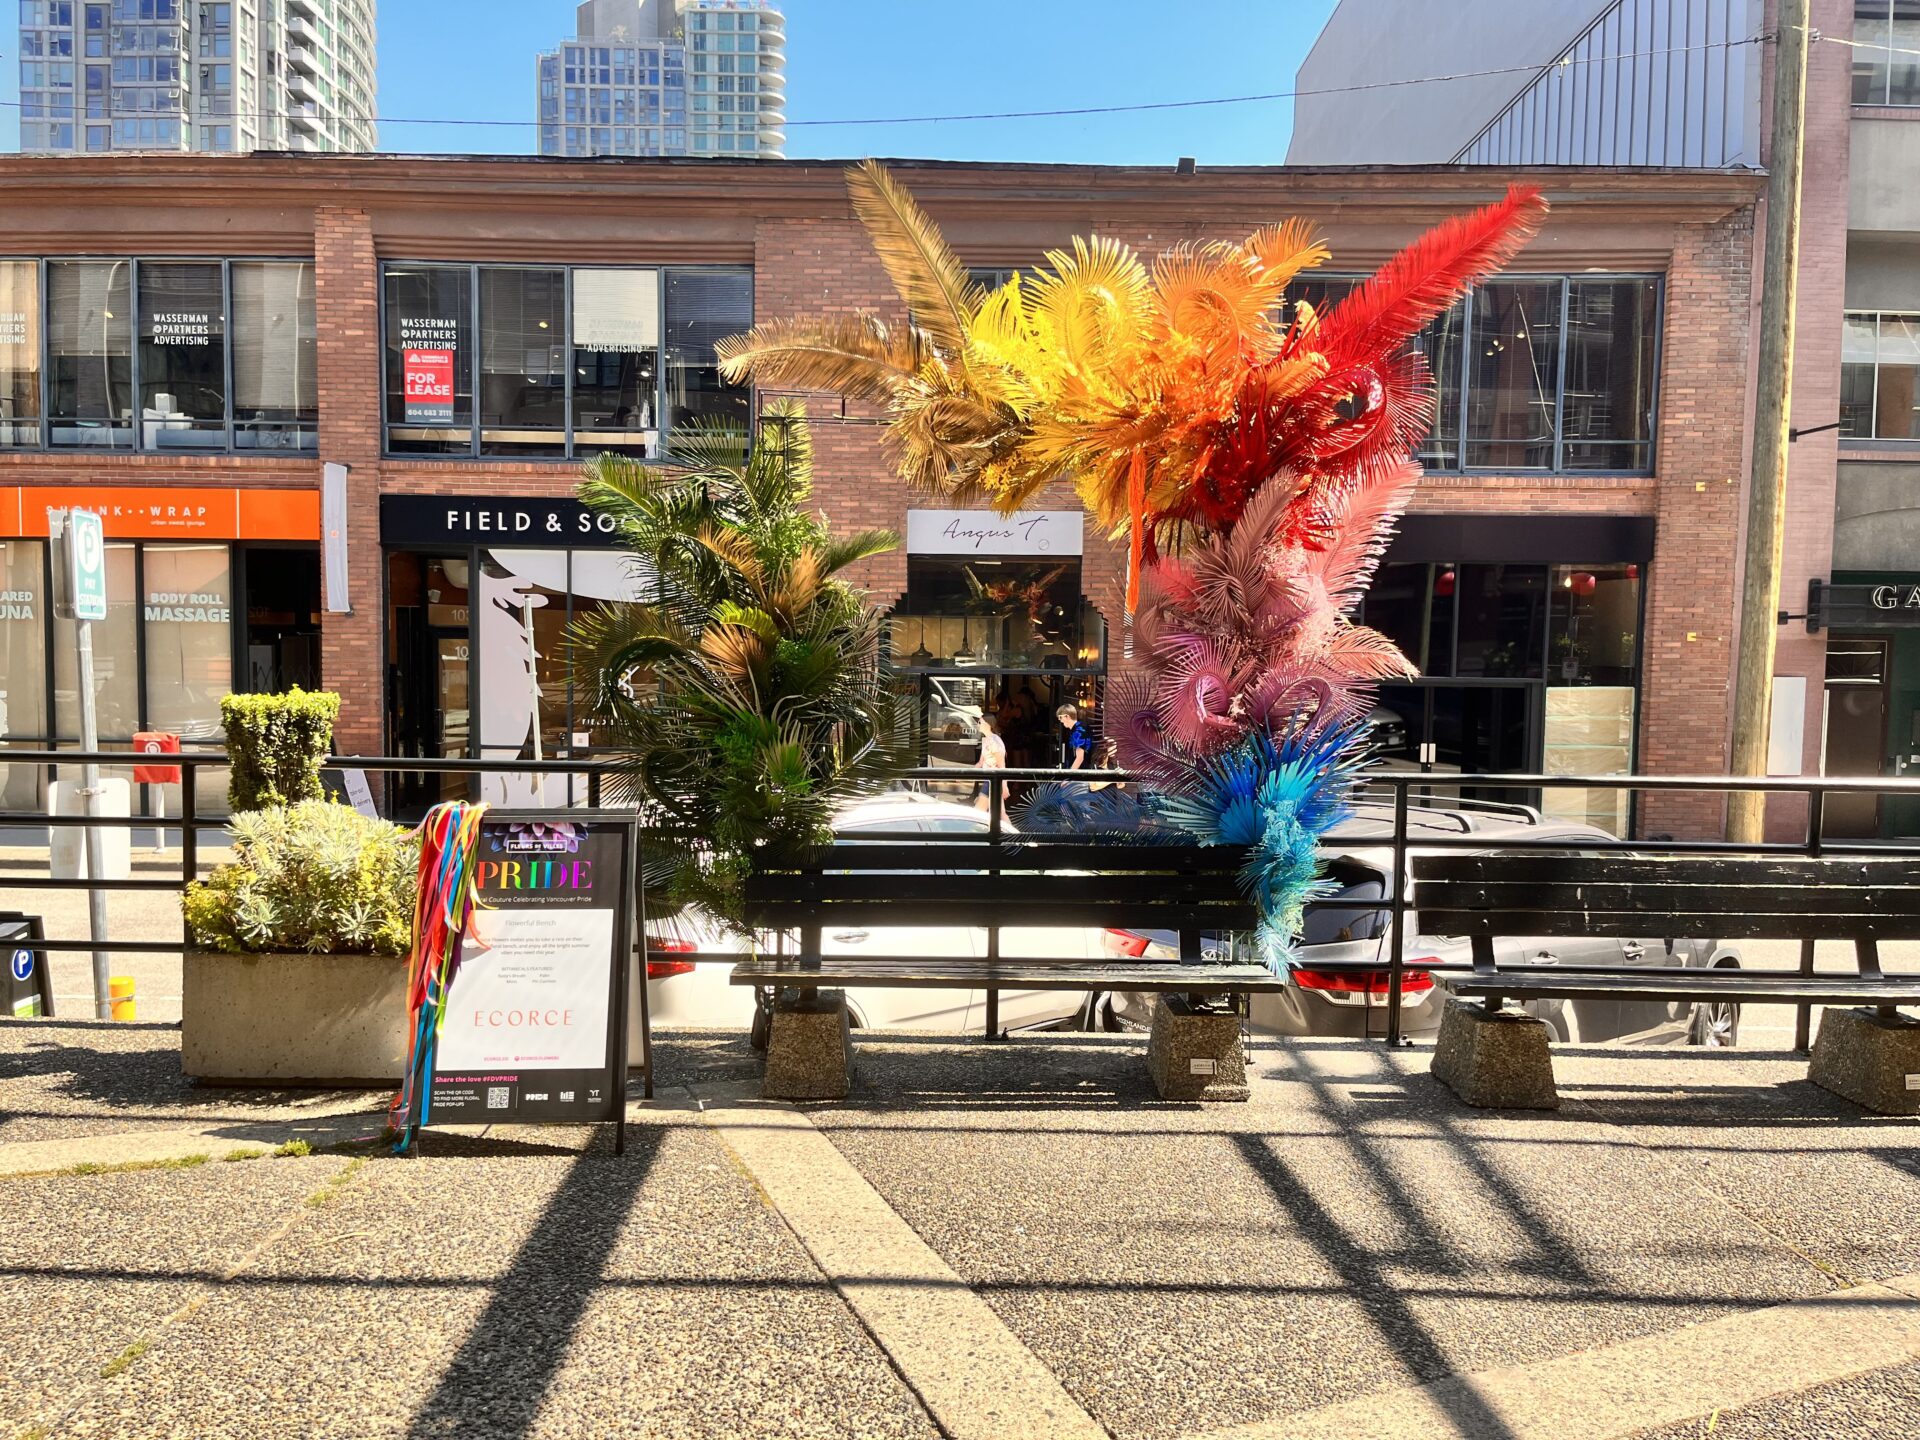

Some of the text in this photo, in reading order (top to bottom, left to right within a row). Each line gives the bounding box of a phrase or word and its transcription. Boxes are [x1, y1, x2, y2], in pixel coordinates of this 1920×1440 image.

[153, 313, 208, 323] WASSERMAN
[401, 318, 456, 328] WASSERMAN
[162, 324, 209, 334] PARTNERS
[410, 330, 457, 339] PARTNERS
[153, 335, 209, 345] ADVERTISING
[401, 341, 457, 350] ADVERTISING
[587, 344, 642, 353] ADVERTISING
[407, 373, 436, 384] FOR
[407, 385, 450, 396] LEASE
[150, 506, 206, 517] WRAP
[447, 510, 531, 531] FIELD
[546, 513, 562, 532] &
[943, 514, 1049, 548] Angus T
[150, 592, 223, 605] BODY ROLL
[1872, 585, 1920, 609] GA
[144, 606, 230, 623] MASSAGE
[477, 860, 593, 889] PRIDE
[513, 896, 546, 904] Celebrating
[474, 1009, 574, 1027] ECORCE
[1115, 1015, 1153, 1033] HIGHLANDE
